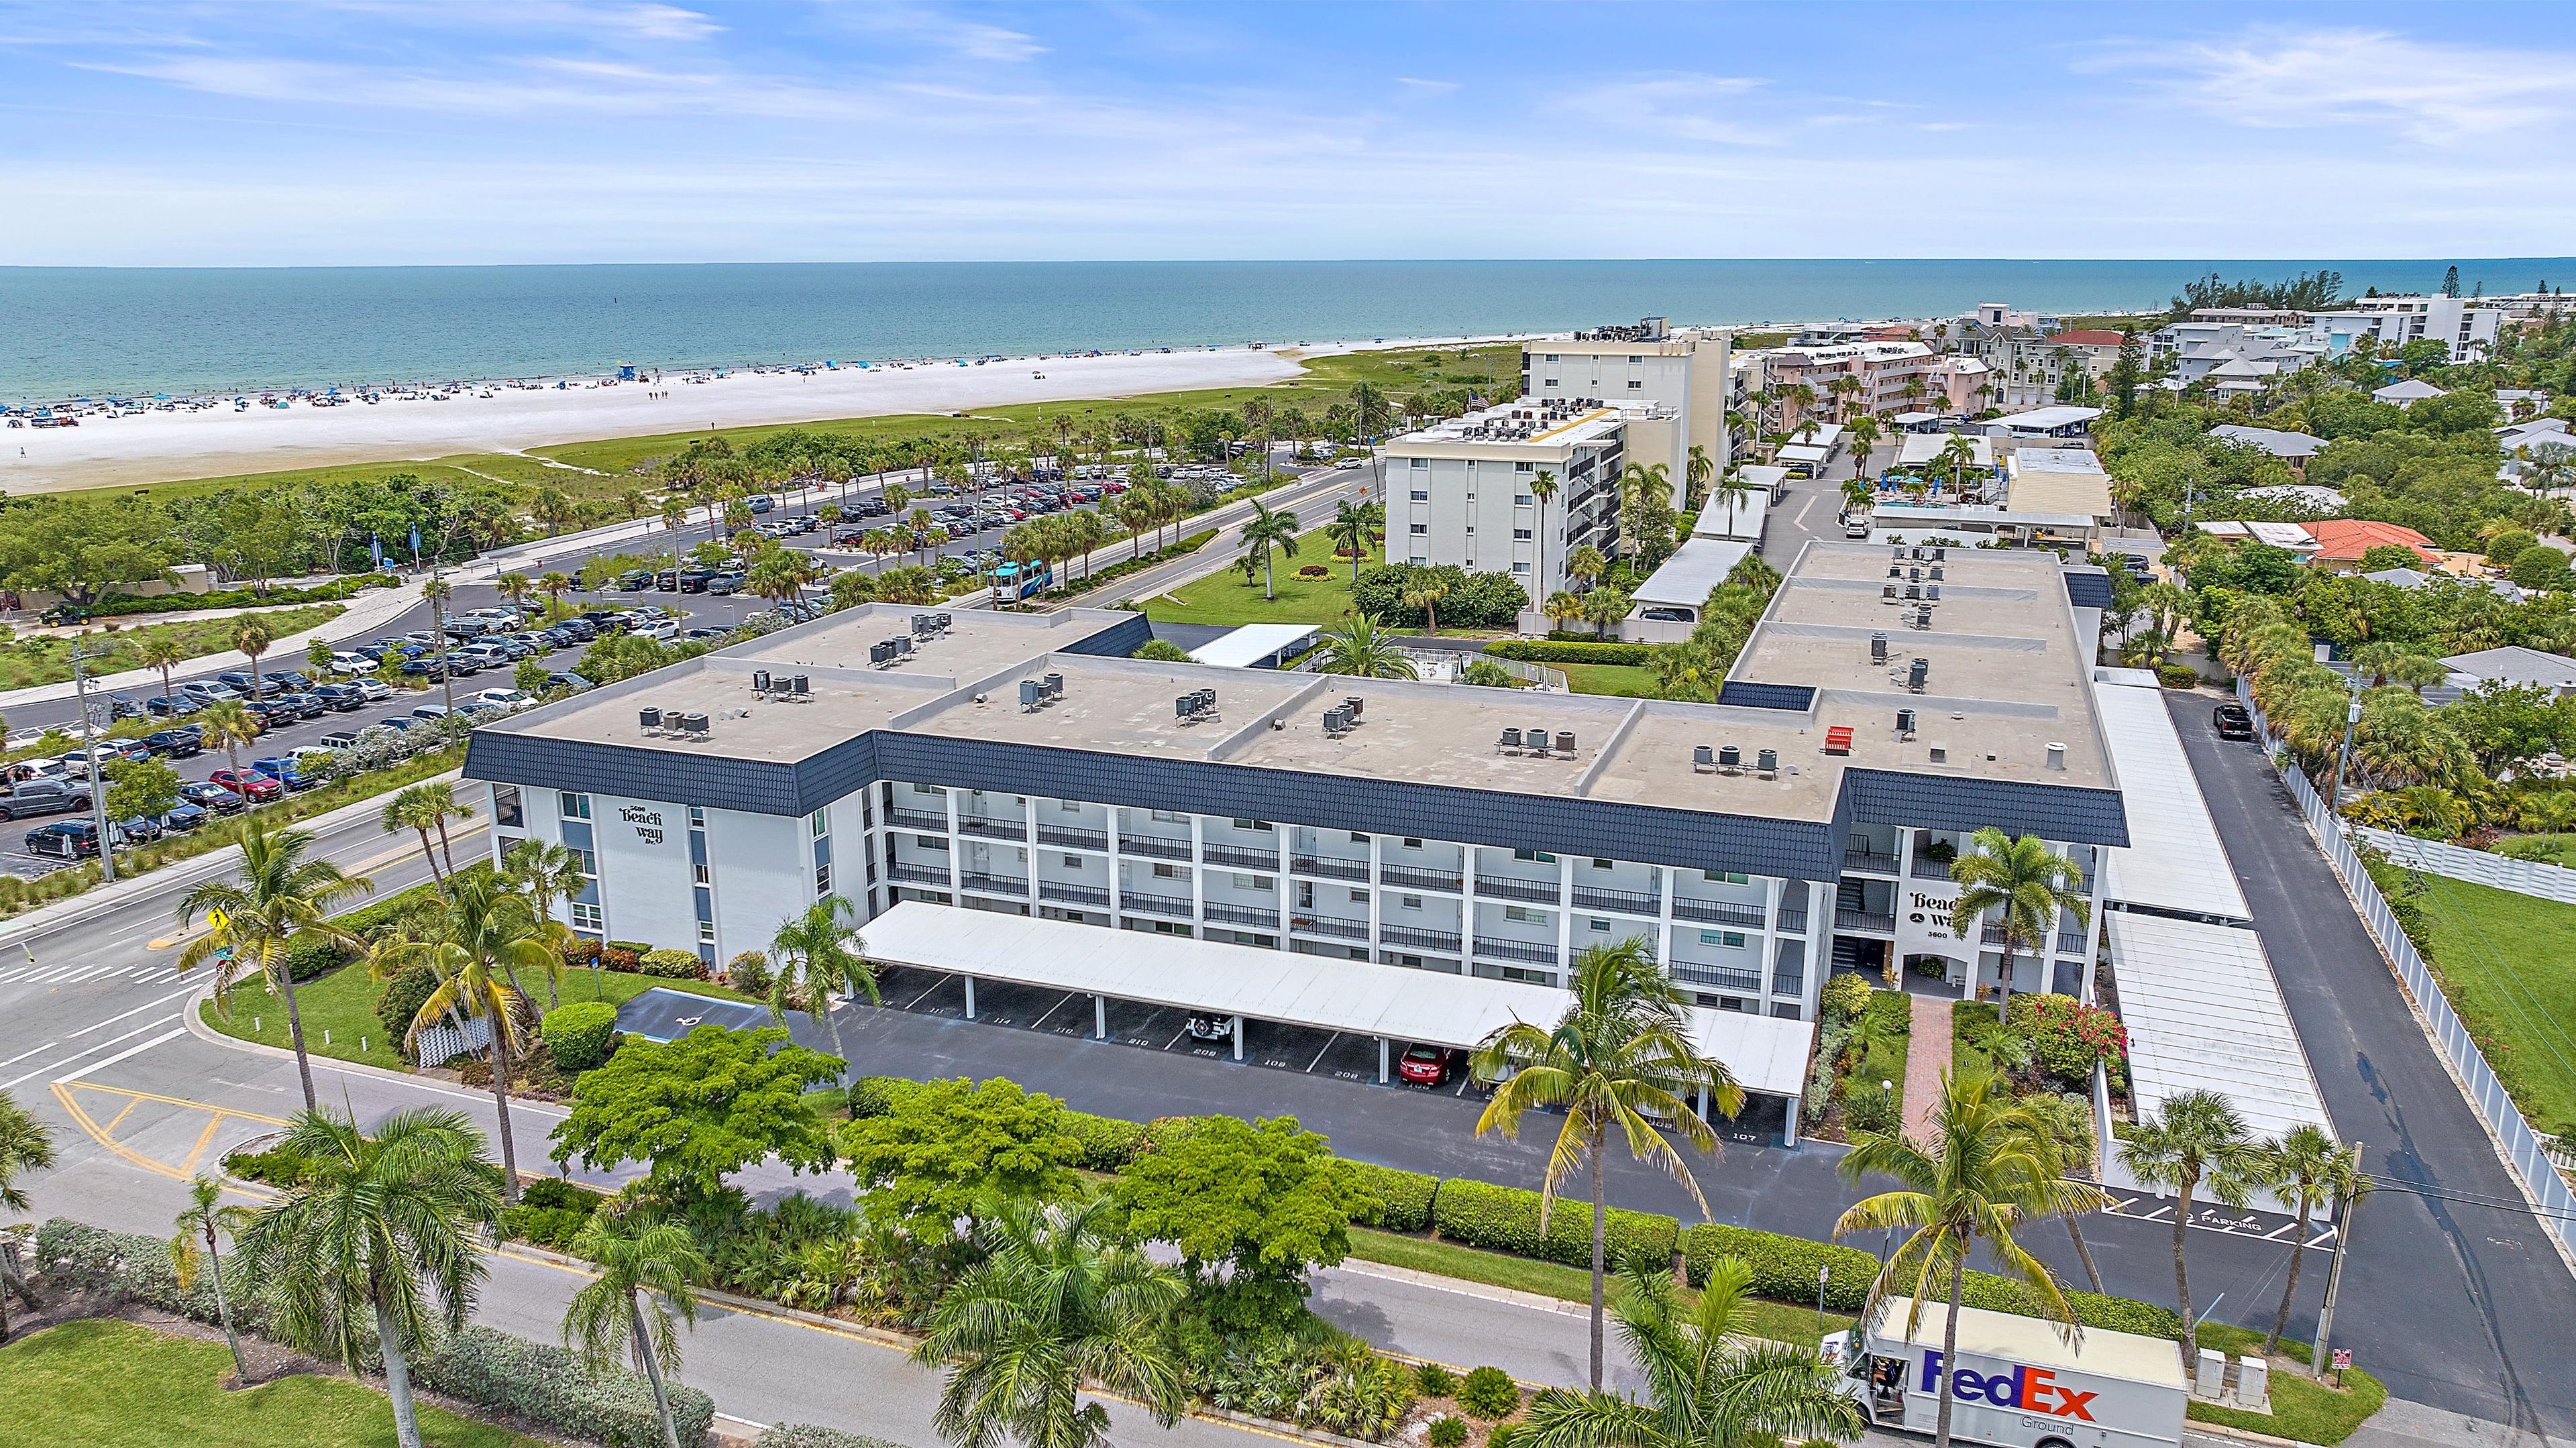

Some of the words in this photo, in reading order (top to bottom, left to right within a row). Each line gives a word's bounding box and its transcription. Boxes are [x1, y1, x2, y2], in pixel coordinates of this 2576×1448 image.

[1733, 1133, 1756, 1141] 107
[2201, 1215, 2262, 1231] PARKING
[1921, 1349, 2099, 1422] FedEx
[2021, 1416, 2074, 1436] Ground
